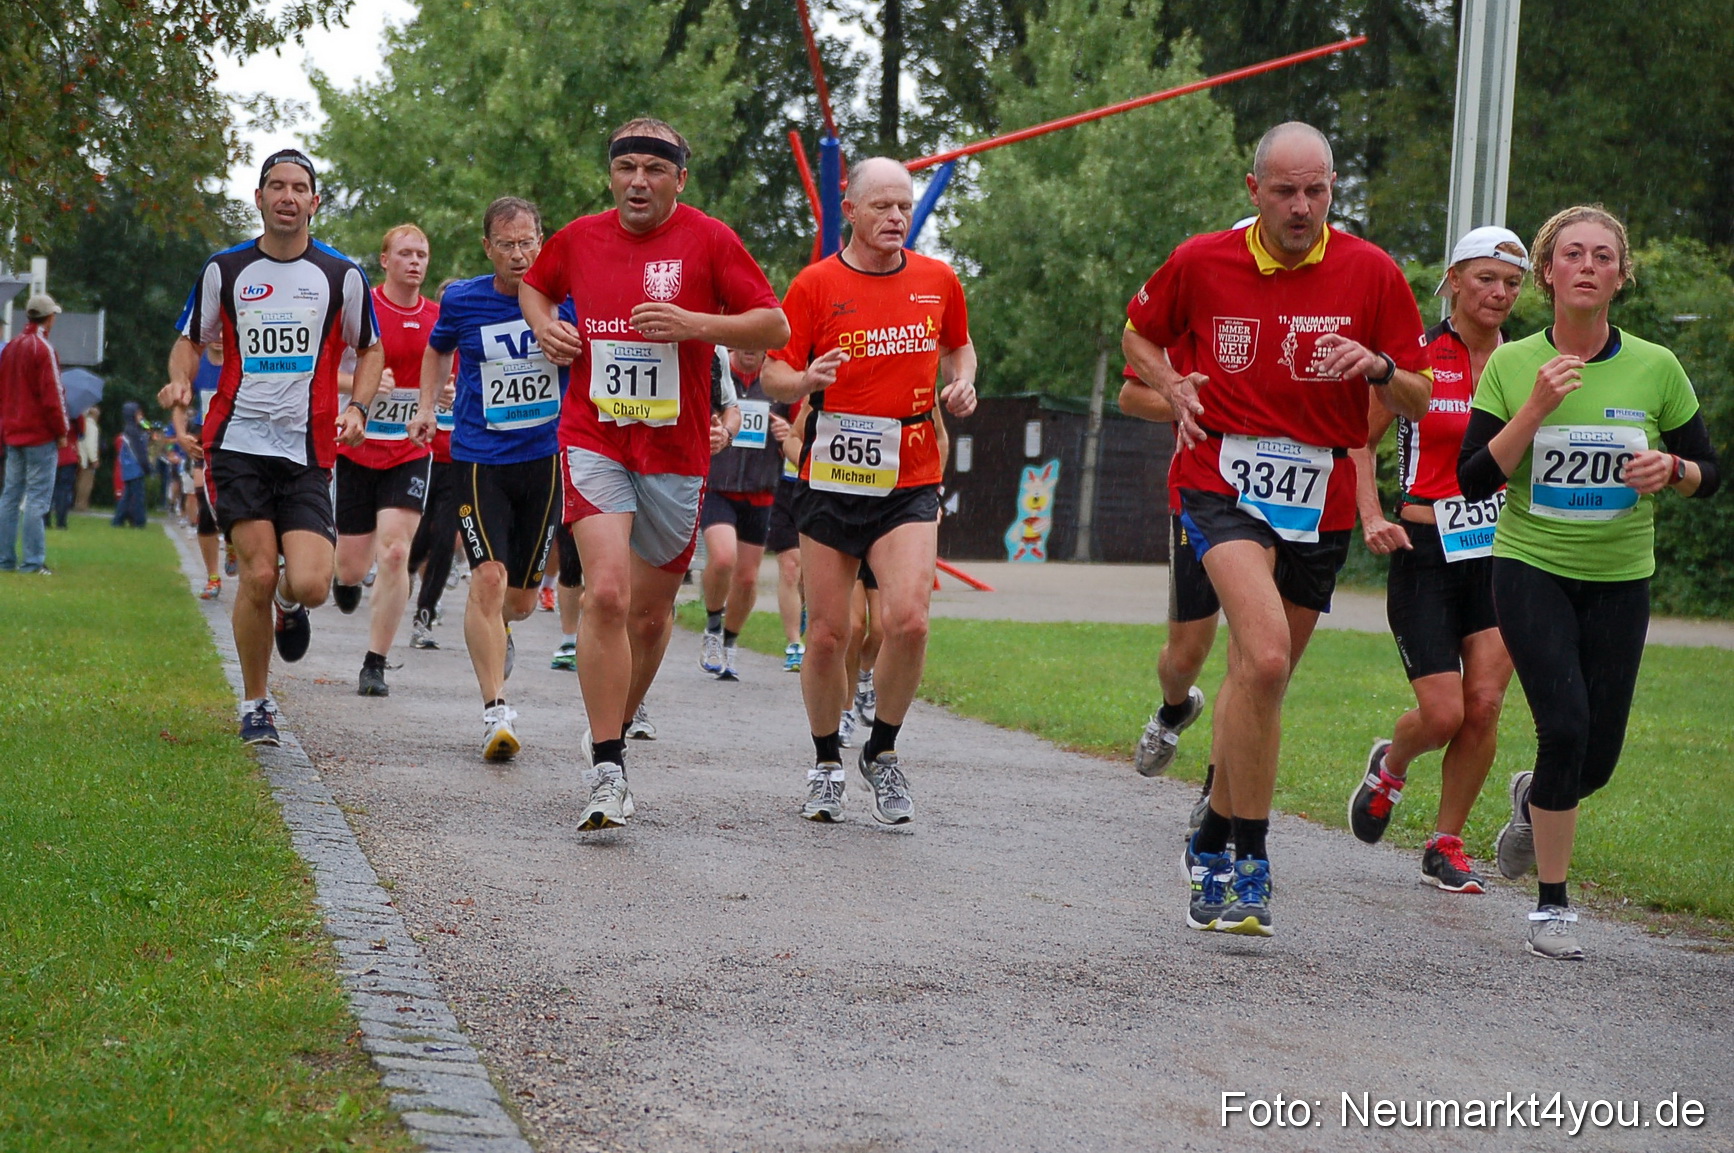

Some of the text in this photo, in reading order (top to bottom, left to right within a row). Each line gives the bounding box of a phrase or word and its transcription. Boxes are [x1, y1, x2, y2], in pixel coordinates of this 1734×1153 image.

[242, 285, 265, 295] tkn
[1278, 315, 1352, 326] 11. NEUMARKTER
[1290, 324, 1339, 332] STADTLAUF
[866, 322, 925, 343] MARATÓ
[1218, 324, 1250, 334] IMMER
[247, 327, 310, 354] 3059
[1218, 333, 1252, 344] WIEDER
[1219, 342, 1248, 356] NEU
[260, 361, 296, 370] Markus
[1219, 354, 1248, 364] MARKT
[606, 364, 658, 396] 311
[490, 375, 552, 405] 2462
[374, 401, 419, 422] 2416
[506, 408, 540, 420] Johann
[614, 402, 650, 418] Charly
[830, 434, 882, 466] 655
[1542, 450, 1635, 484] 2208
[831, 468, 876, 484] Michael
[1231, 459, 1320, 504] 3347
[1568, 493, 1602, 506] Julia
